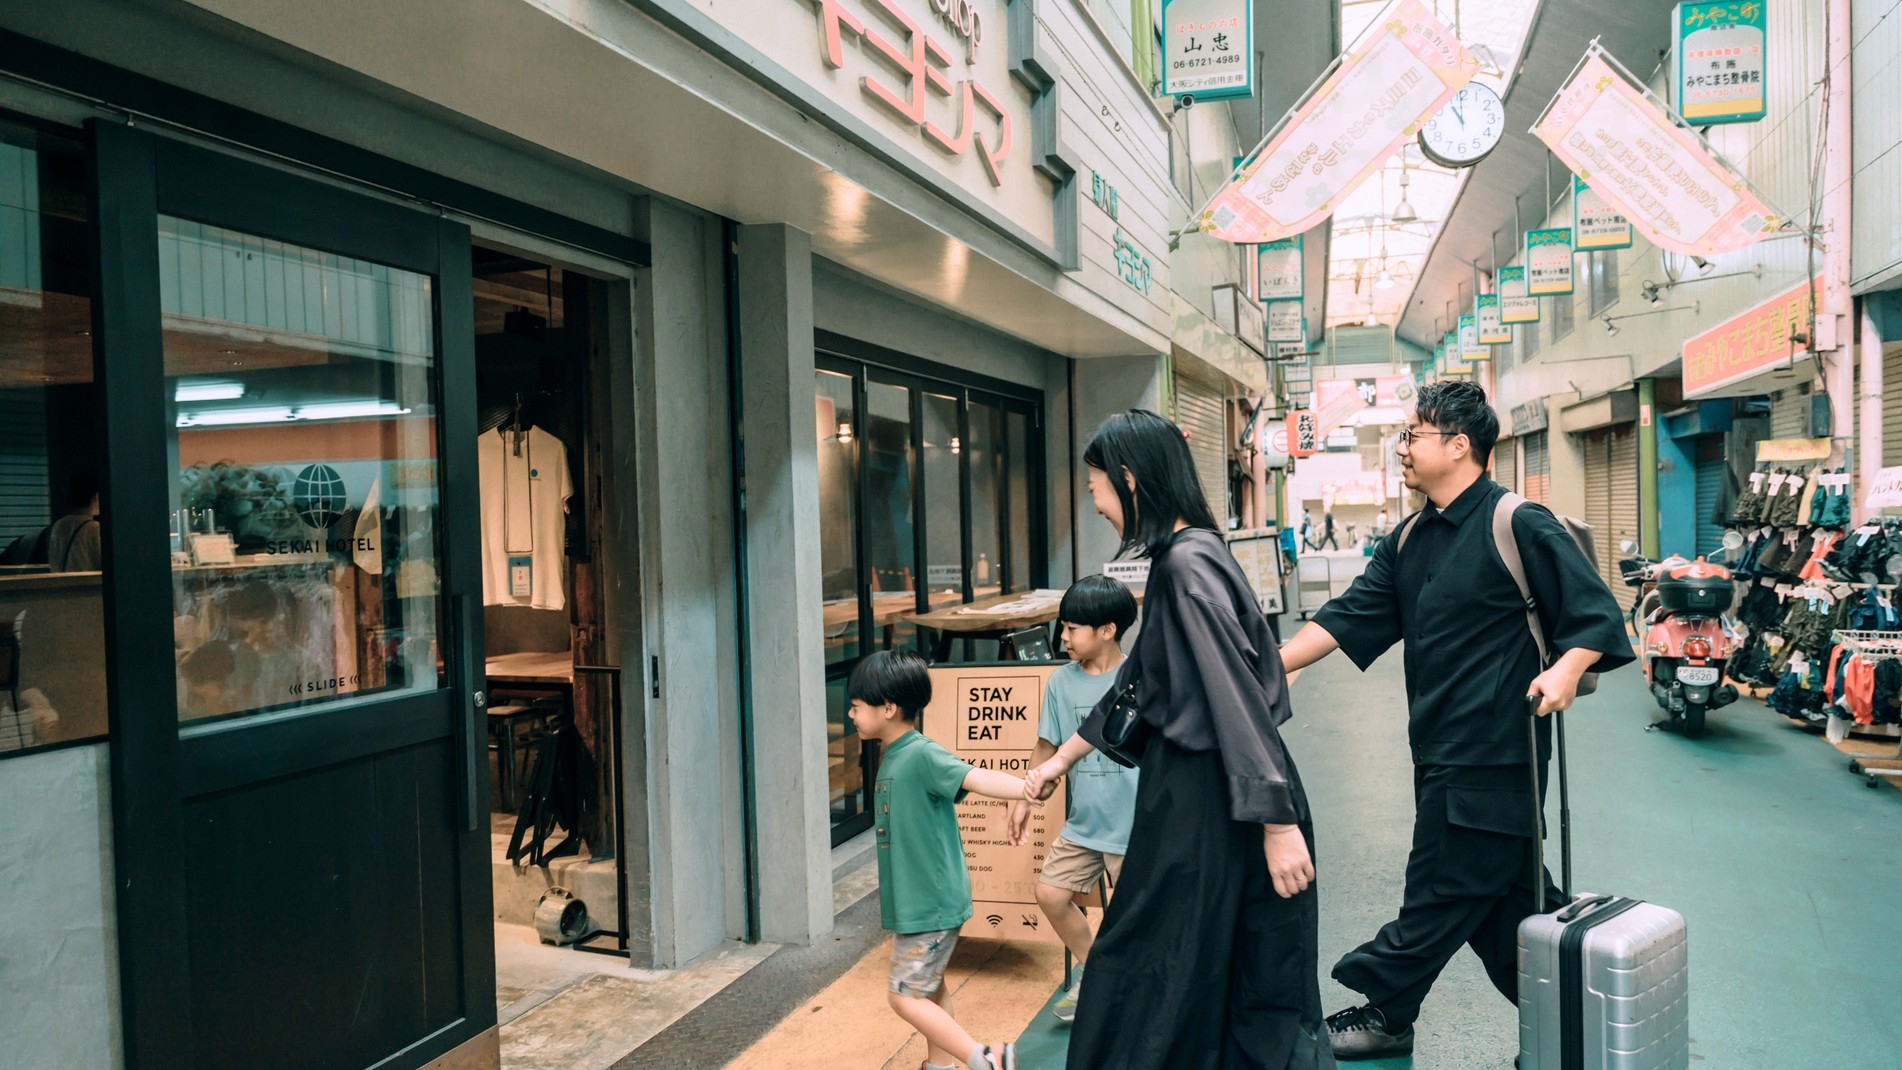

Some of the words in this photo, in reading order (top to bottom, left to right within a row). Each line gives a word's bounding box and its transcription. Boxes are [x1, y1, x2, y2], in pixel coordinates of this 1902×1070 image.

[933, 0, 983, 65] op
[1176, 17, 1239, 33] はきものの店
[1184, 33, 1229, 53] 山忠
[1686, 70, 1760, 88] みやこまち整骨院
[1483, 100, 1491, 111] 2
[1487, 113, 1496, 125] 3
[1482, 127, 1491, 137] 4
[1458, 143, 1466, 154] 6
[1472, 138, 1481, 149] 5
[1113, 226, 1152, 296] キヨシマ
[266, 540, 319, 555] SEKAI
[326, 538, 375, 553] HOTEL
[308, 677, 345, 692] SLIDE
[969, 687, 1013, 702] STAY
[968, 706, 1027, 721] DRINK
[968, 725, 1002, 740] EAT
[961, 758, 993, 770] KAI
